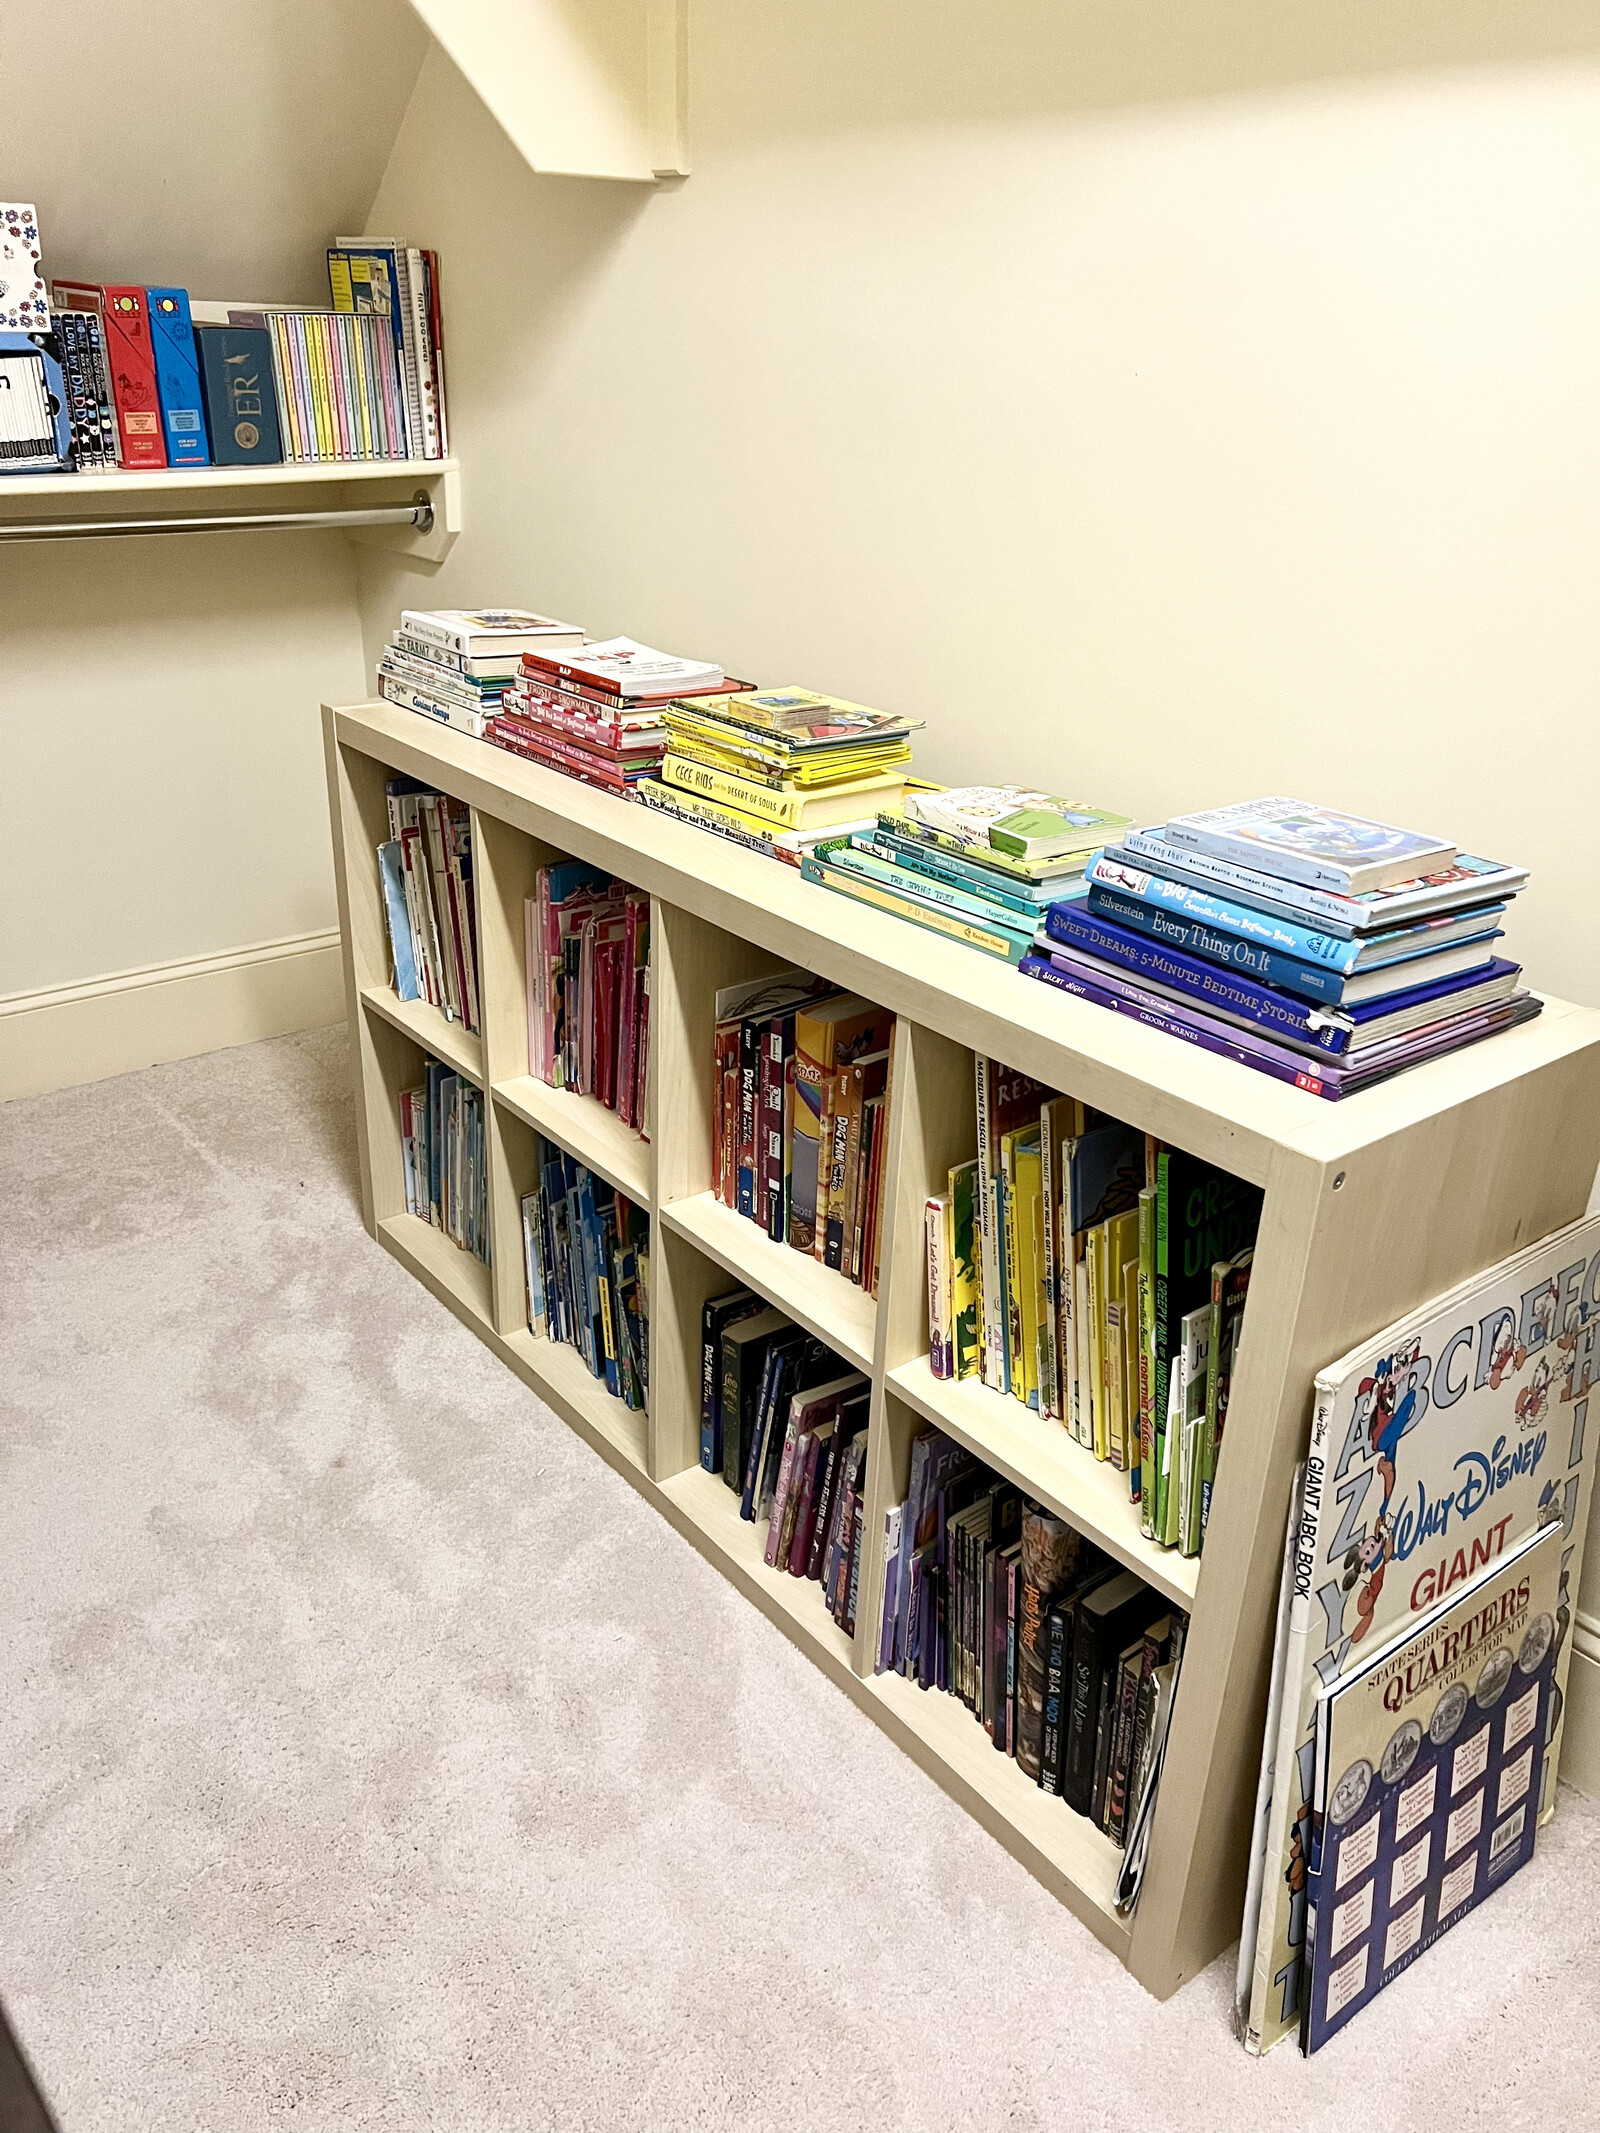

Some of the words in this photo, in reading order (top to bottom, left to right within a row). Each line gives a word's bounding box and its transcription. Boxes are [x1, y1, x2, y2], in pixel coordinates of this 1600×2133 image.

[66, 327, 76, 351] LOVE
[76, 319, 86, 349] ROAR
[87, 315, 100, 350] HOOT
[419, 315, 427, 335] 100
[69, 355, 78, 371] MY
[71, 375, 89, 428] DADDY
[233, 374, 262, 416] ER
[407, 639, 429, 657] FARM?
[559, 667, 572, 675] RAP
[412, 696, 431, 712] Curious
[432, 704, 450, 721] George
[529, 682, 551, 698] FROSTY
[558, 693, 590, 714] SNOWMAN
[645, 785, 659, 798] PETER
[661, 791, 676, 804] BROWN
[676, 765, 692, 783] CECE
[695, 771, 714, 791] RIOS
[727, 786, 748, 801] DESERT
[750, 794, 757, 804] OF
[759, 797, 777, 812] SOULS
[689, 814, 699, 824] and
[700, 819, 711, 830] The
[711, 823, 724, 834] Most
[725, 829, 750, 845] Beautiful
[752, 838, 765, 850] Tree
[701, 807, 715, 820] TIGER
[716, 812, 730, 825] GOES
[730, 819, 741, 830] WILD
[896, 820, 911, 831] DAHL
[1129, 838, 1148, 853] Using
[1149, 844, 1165, 858] Feng
[1167, 849, 1183, 861] Shui
[890, 874, 903, 885] THE
[906, 880, 932, 896] GIVING
[934, 890, 954, 903] TREE
[975, 886, 1003, 903] Eastman
[1153, 882, 1163, 891] The
[1162, 881, 1189, 900] BIG
[985, 907, 1018, 924] HarperCollins
[1099, 894, 1145, 921] Silverstein
[1183, 899, 1219, 919] Berenstain
[1219, 911, 1241, 927] Bears
[1240, 919, 1273, 938] Beginner
[1273, 930, 1297, 947] Books
[972, 931, 989, 944] Random
[1152, 910, 1189, 944] Every
[1191, 924, 1232, 960] Thing
[1234, 942, 1256, 966] On
[1260, 950, 1271, 971] It
[1042, 971, 1065, 988] SILENT
[1052, 914, 1089, 939] SWEET
[1089, 928, 1139, 960] DREAMS:
[1140, 952, 1201, 986] 5-MINUTE
[1202, 976, 1259, 1009] BEDTIME
[1260, 1001, 1311, 1032] STORIE
[1301, 972, 1325, 988] HARPER
[1139, 1012, 1165, 1028] GROOM
[1170, 1023, 1199, 1041] WARNES
[743, 1068, 754, 1091] DOG
[762, 1054, 770, 1094] Goodnight
[977, 1060, 986, 1115] MADELINE'S
[743, 1090, 752, 1113] MAN
[836, 1115, 849, 1140] DOG
[850, 1111, 859, 1153] AMULET
[978, 1116, 986, 1150] RESCUE
[834, 1137, 847, 1162] MAN
[1042, 1120, 1050, 1183] LUCIANI/THARLET
[982, 1190, 990, 1237] BEMELMANS
[1045, 1228, 1050, 1238] WE
[930, 1243, 938, 1261] Let's
[1046, 1254, 1051, 1262] TO
[930, 1262, 938, 1279] Get
[930, 1280, 941, 1323] Dressed!
[1140, 1285, 1148, 1328] Berenstain
[1156, 1279, 1168, 1322] CREEPY
[639, 1337, 647, 1355] MANY
[1157, 1322, 1168, 1344] PAIR
[704, 1344, 713, 1364] DOG
[704, 1362, 713, 1383] MAN
[1140, 1354, 1149, 1406] STORYTIME
[1156, 1357, 1168, 1430] UNDERWEAR!
[1140, 1408, 1149, 1462] TREASURY
[1306, 1455, 1324, 1511] GIANT
[1141, 1486, 1149, 1517] DOVER
[1301, 1512, 1320, 1549] ABC
[1294, 1552, 1313, 1599] BOOK
[1410, 1513, 1514, 1613] GIANT
[1024, 1583, 1040, 1616] Harry
[1023, 1616, 1039, 1651] Potter
[1050, 1614, 1064, 1640] ONE
[1050, 1641, 1063, 1666] TWO
[1367, 1651, 1406, 1692] STATE
[1406, 1619, 1449, 1662] SERIES
[1381, 1572, 1531, 1724] QUARTERS
[1438, 1631, 1502, 1692] COLLECTOR
[1506, 1612, 1527, 1638] MAP
[1048, 1667, 1060, 1693] BAA
[1077, 1662, 1090, 1678] So
[1077, 1678, 1089, 1698] This
[1121, 1672, 1138, 1713] KISS
[1046, 1694, 1059, 1724] MOO
[1075, 1698, 1086, 1709] Is
[1072, 1708, 1086, 1733] Love
